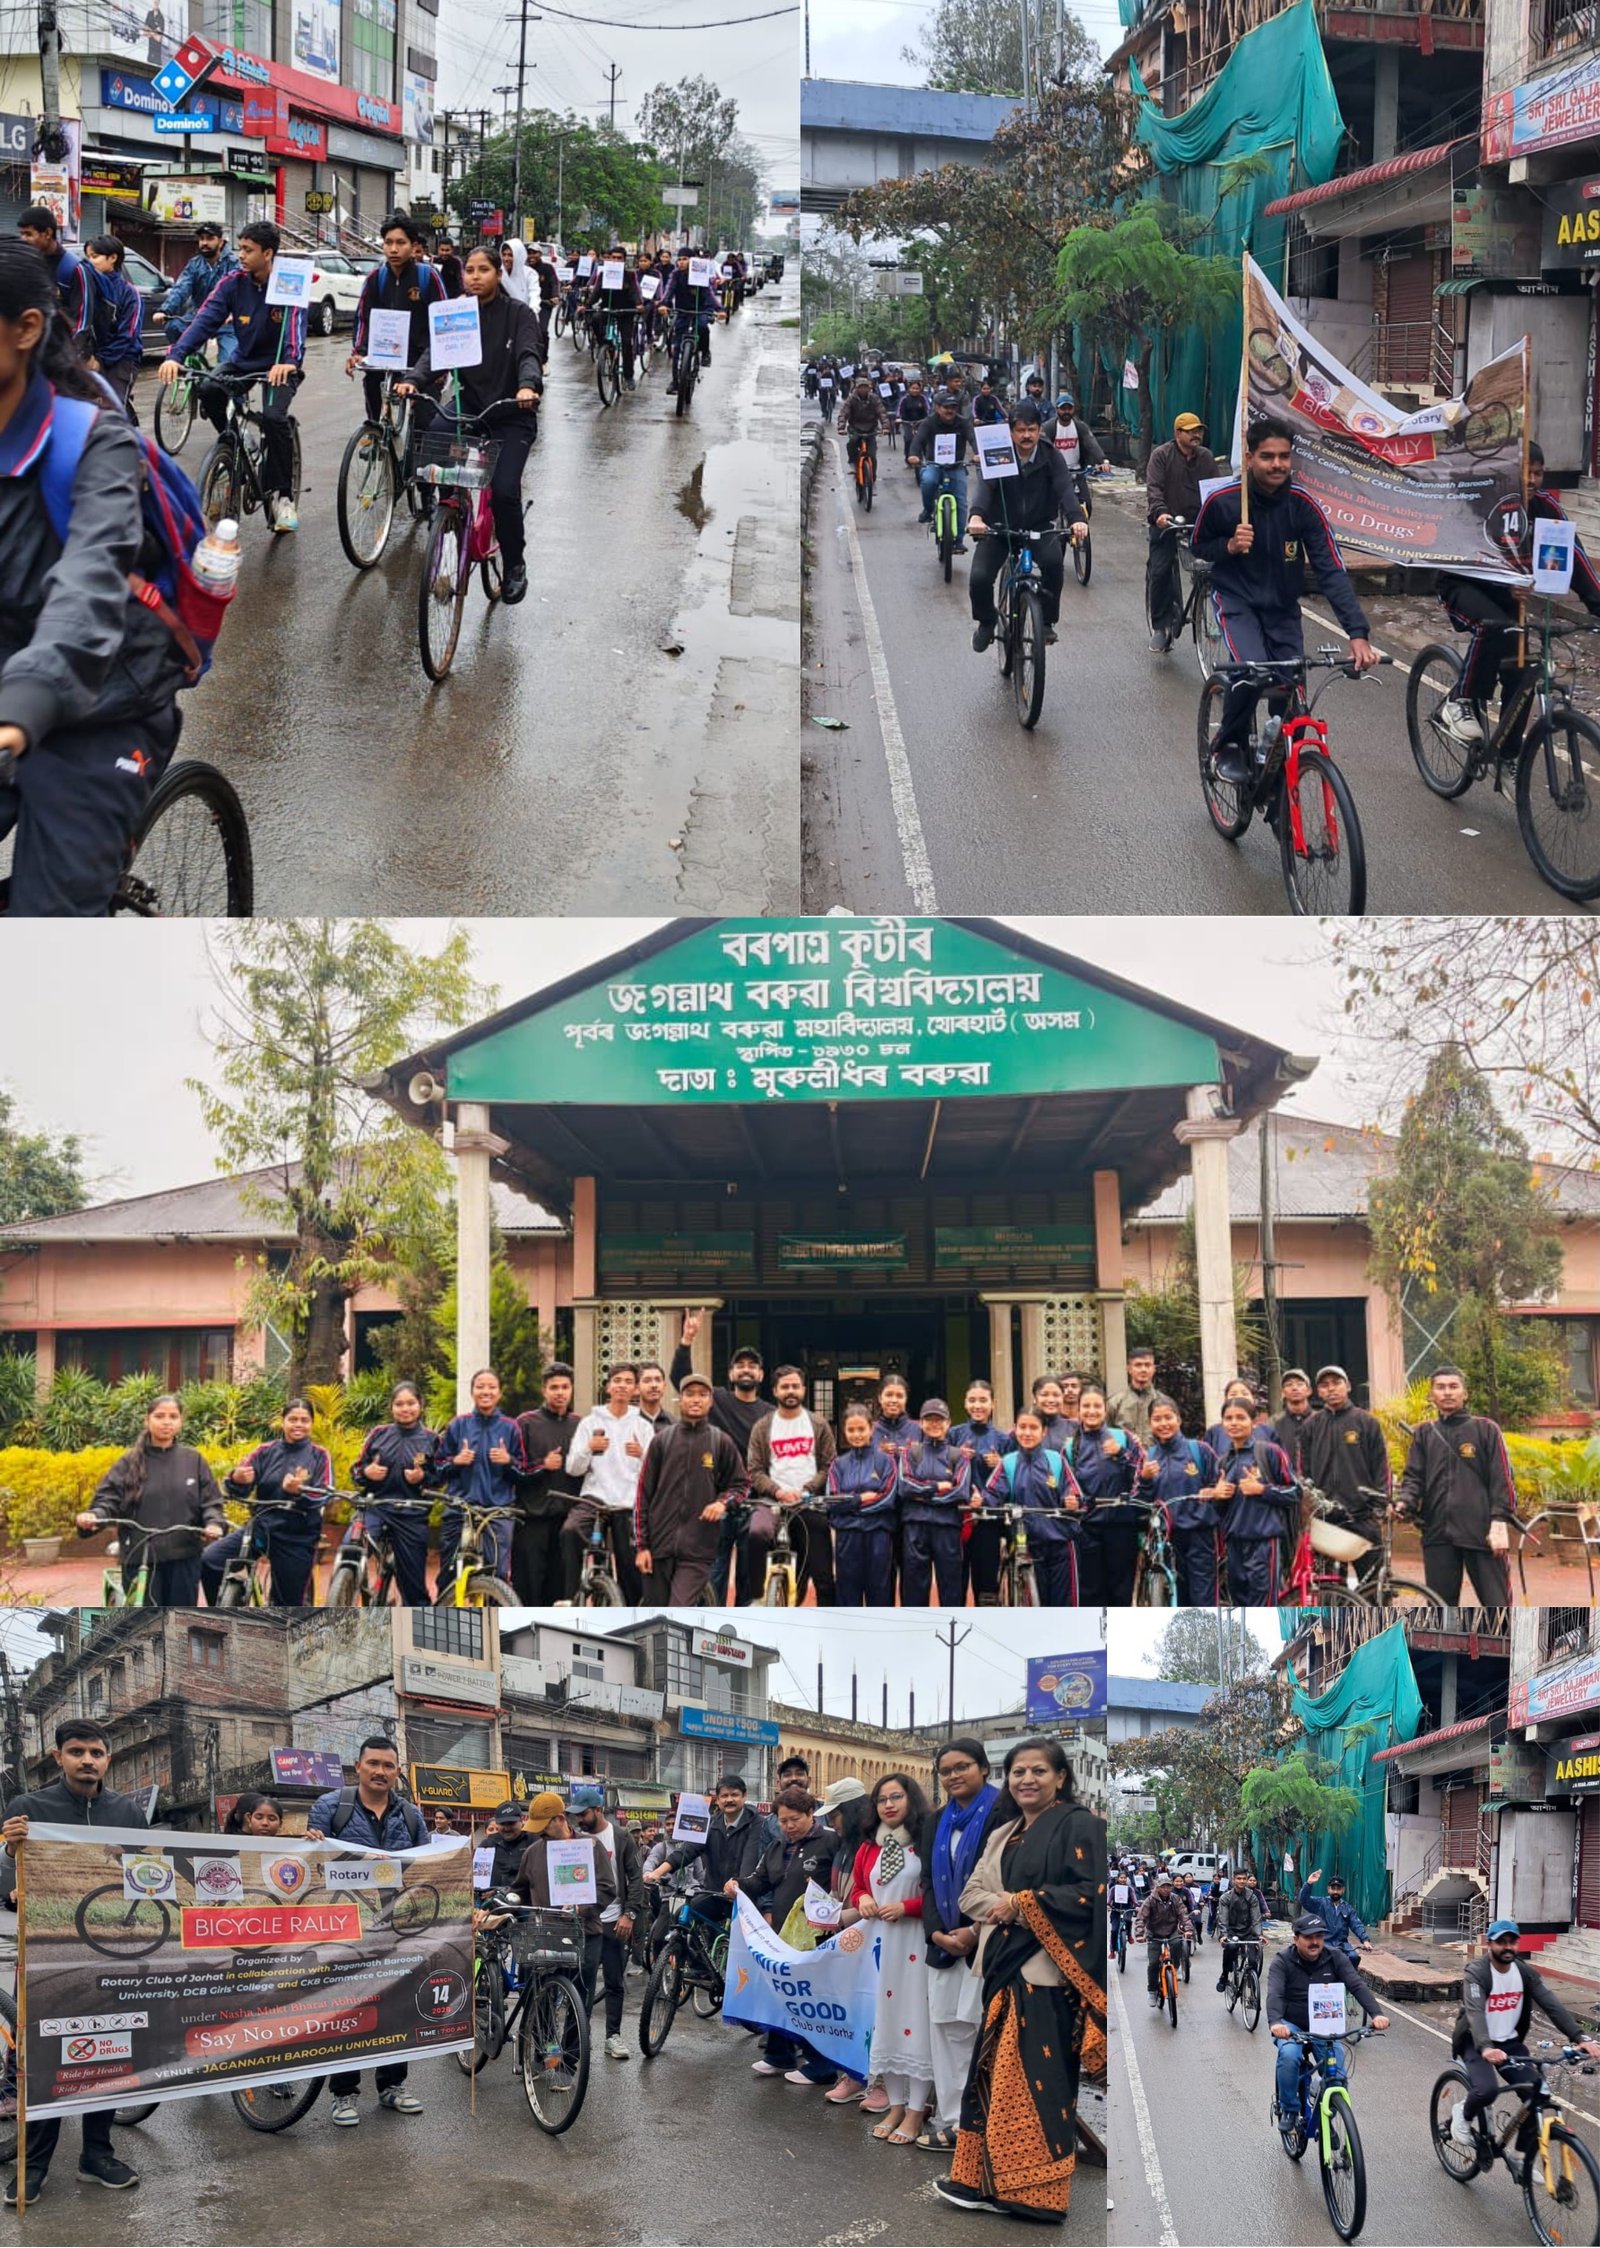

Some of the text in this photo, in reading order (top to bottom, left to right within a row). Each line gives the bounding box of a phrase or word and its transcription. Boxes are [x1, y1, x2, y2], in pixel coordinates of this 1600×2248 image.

[1528, 99, 1545, 120] SRI
[1549, 93, 1566, 113] SRI
[157, 117, 209, 129] Domino's
[0, 122, 26, 150] LG
[1406, 412, 1442, 425] otary
[1293, 434, 1312, 447] rhat
[1312, 440, 1321, 451] in
[1321, 446, 1380, 476] collaboration
[1381, 471, 1403, 482] with
[1457, 477, 1494, 488] Barooah
[1318, 457, 1351, 476] College
[1351, 472, 1371, 483] and
[1371, 478, 1392, 490] CKB
[1393, 485, 1445, 500] Commerce
[1337, 507, 1354, 522] to
[1502, 511, 1519, 533] 14
[1334, 533, 1468, 562] BAROOAH UNIVERSITY
[607, 983, 734, 1014] জগন্নাথ
[624, 1021, 711, 1043] জগন্নাথ
[656, 1068, 717, 1092] দাতা
[703, 1714, 735, 1728] UNDER
[421, 1786, 453, 1796] V-GUARD
[329, 1869, 369, 1881] Rotary
[195, 1914, 349, 1938] BICYCLE RALLY
[101, 1954, 424, 1988] Rotary Club of Jorhat in collaboration with Jagannath Barooah
[236, 1955, 303, 1967] Organized by
[118, 1990, 180, 2001] University,
[183, 1987, 208, 1997] DCB
[236, 1981, 275, 1993] College
[277, 1980, 298, 1989] and
[300, 1978, 321, 1987] CKB
[323, 1973, 375, 1985] Commerce
[432, 1985, 450, 2004] 14
[772, 1978, 812, 1997] FOR
[181, 2011, 217, 2024] under
[220, 2008, 254, 2021] Nasha
[257, 2003, 287, 2017] Mukt
[290, 1999, 329, 2012] Bharat
[786, 2001, 847, 2021] GOOD
[242, 2027, 273, 2043] No
[279, 2023, 300, 2038] to
[420, 2029, 436, 2037] TIME
[791, 2017, 814, 2031] Club
[816, 2025, 826, 2034] of
[100, 2039, 112, 2047] NO
[100, 2046, 129, 2055] DRUGS
[155, 2033, 409, 2079] VENUE JAGANNATH BAROOAH UNIVERSITY
[82, 2069, 95, 2078] for
[79, 2083, 90, 2091] for
